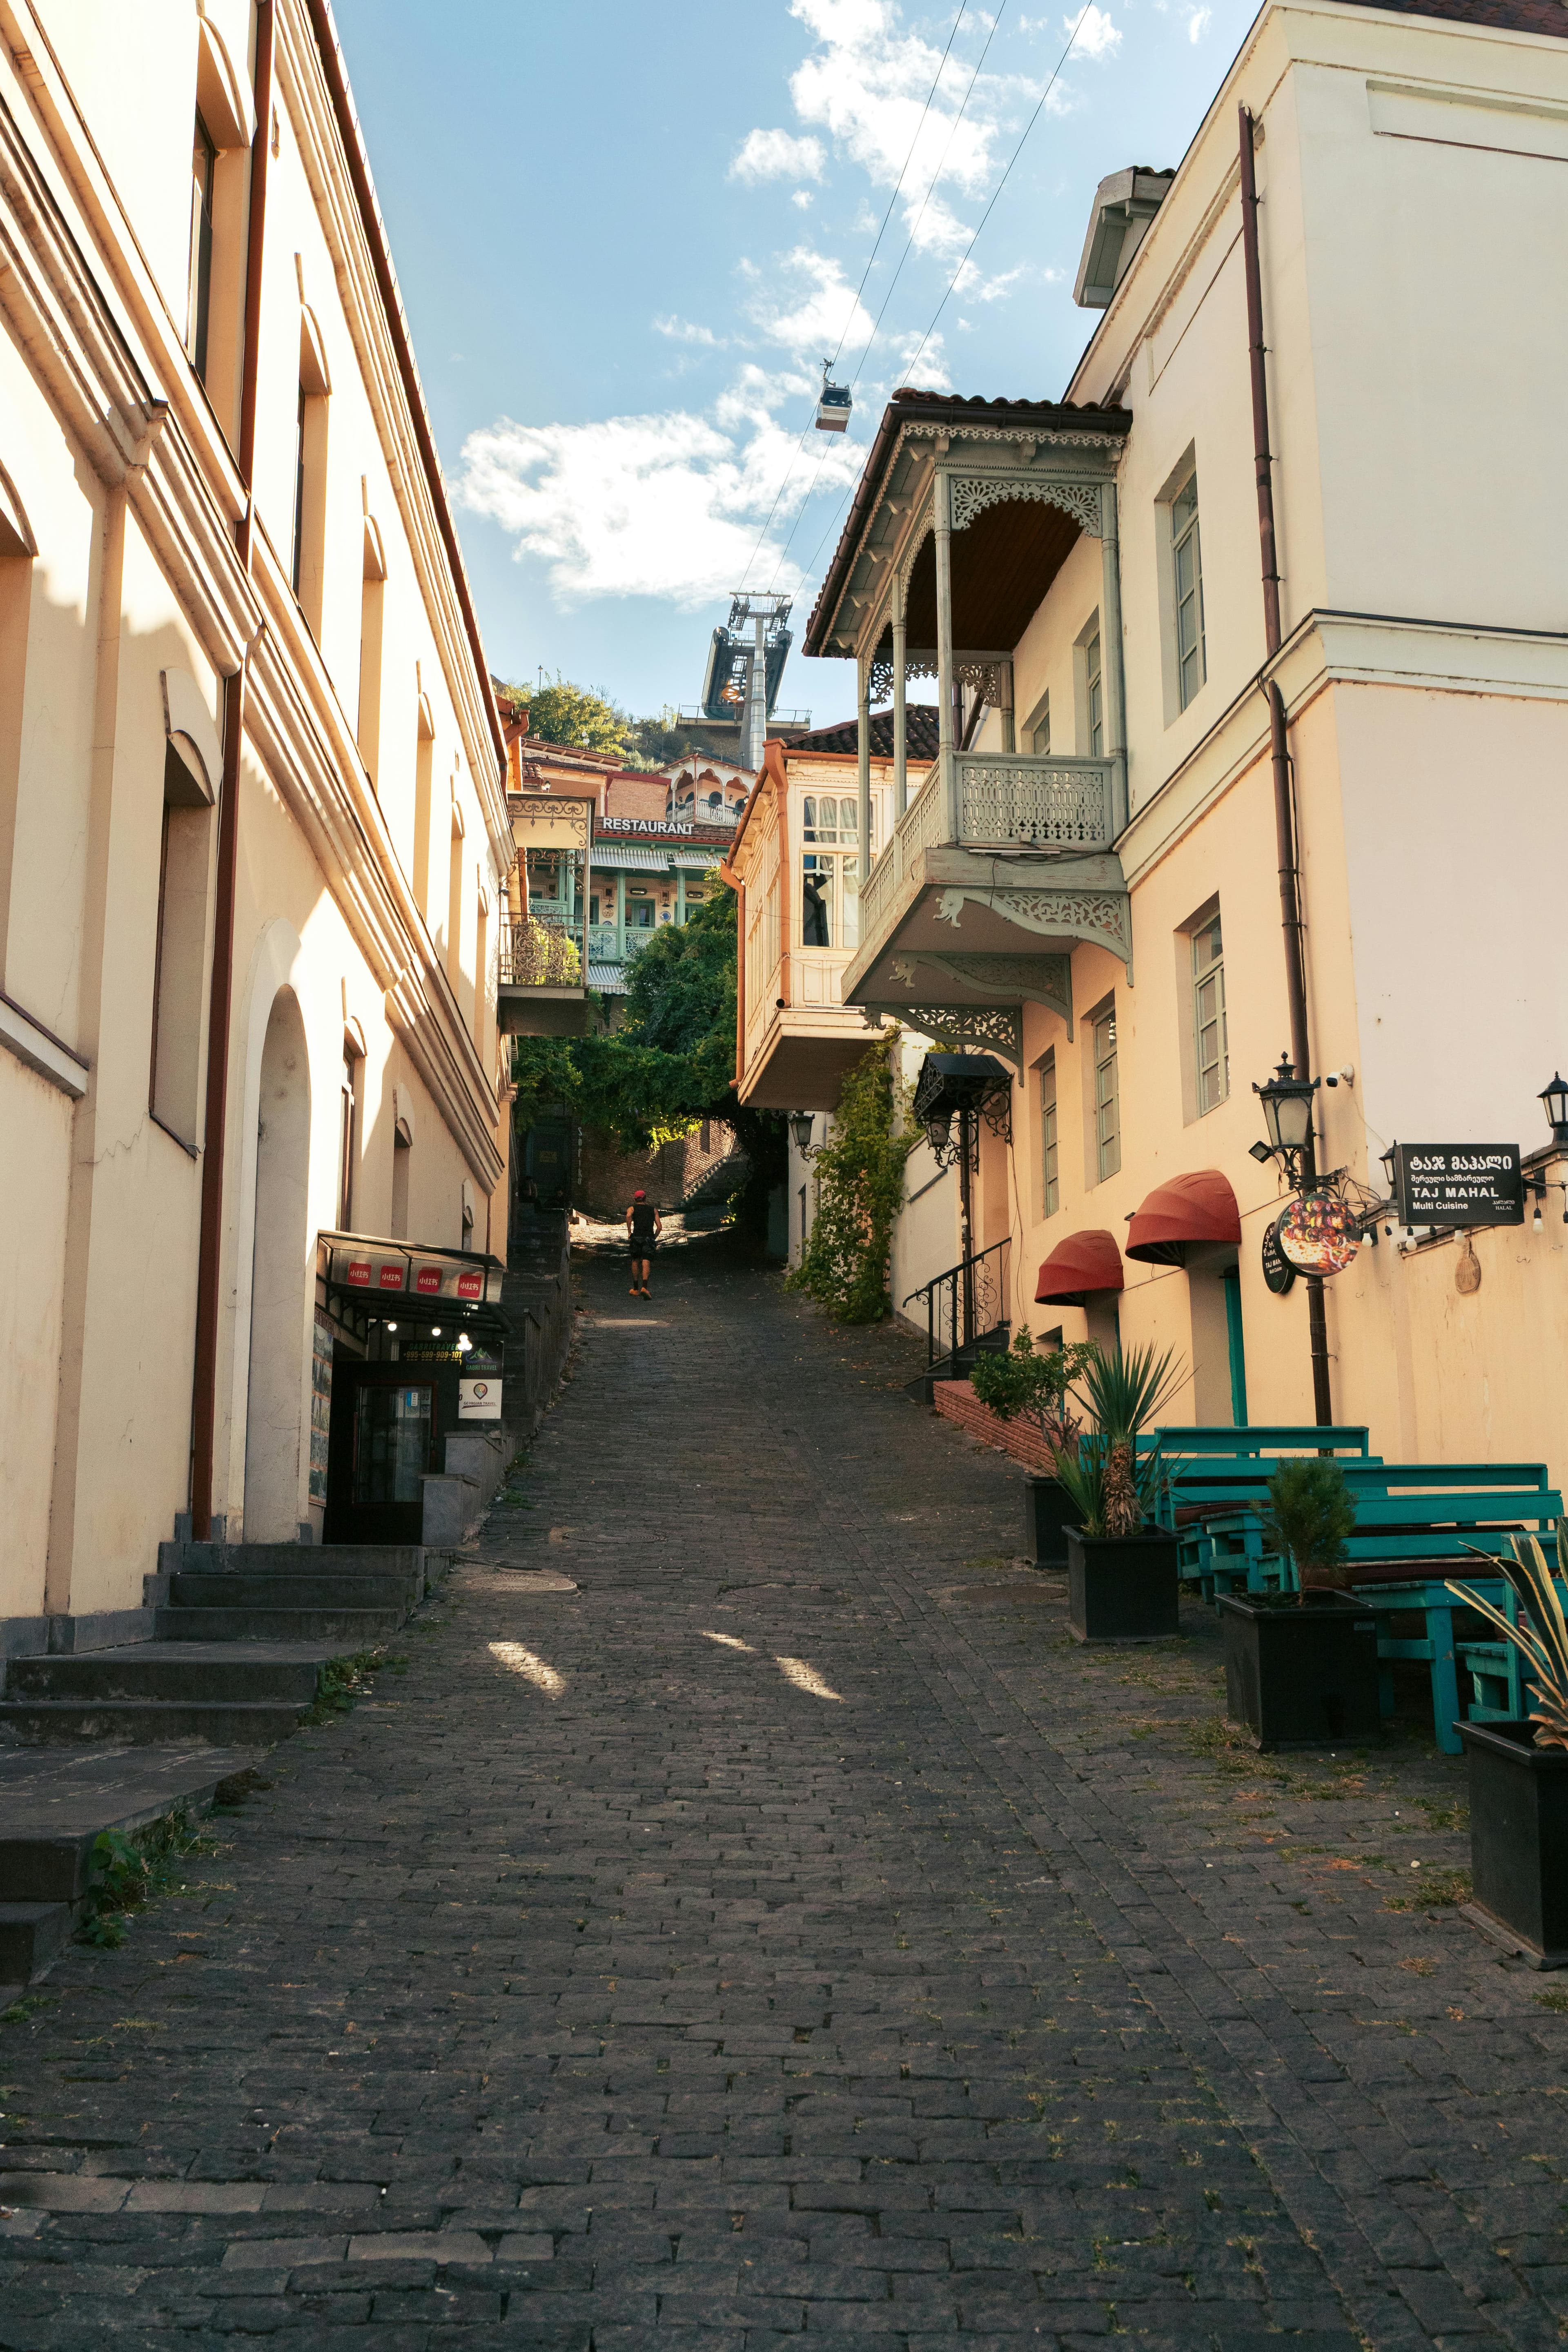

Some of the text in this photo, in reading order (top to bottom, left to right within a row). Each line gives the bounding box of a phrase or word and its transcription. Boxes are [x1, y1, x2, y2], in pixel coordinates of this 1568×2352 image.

[603, 817, 694, 835] RESTAURANT
[1410, 1156, 1512, 1170] ტაჯ მაჰალი
[1411, 1174, 1494, 1183] შერეული სამზარეულო
[1412, 1187, 1499, 1198] TAJ MAHAL
[1412, 1202, 1434, 1210] Multi
[350, 1270, 368, 1278] 小红书
[382, 1272, 400, 1281] 小红书
[419, 1277, 438, 1286] 小红书
[460, 1282, 479, 1290] 小红书
